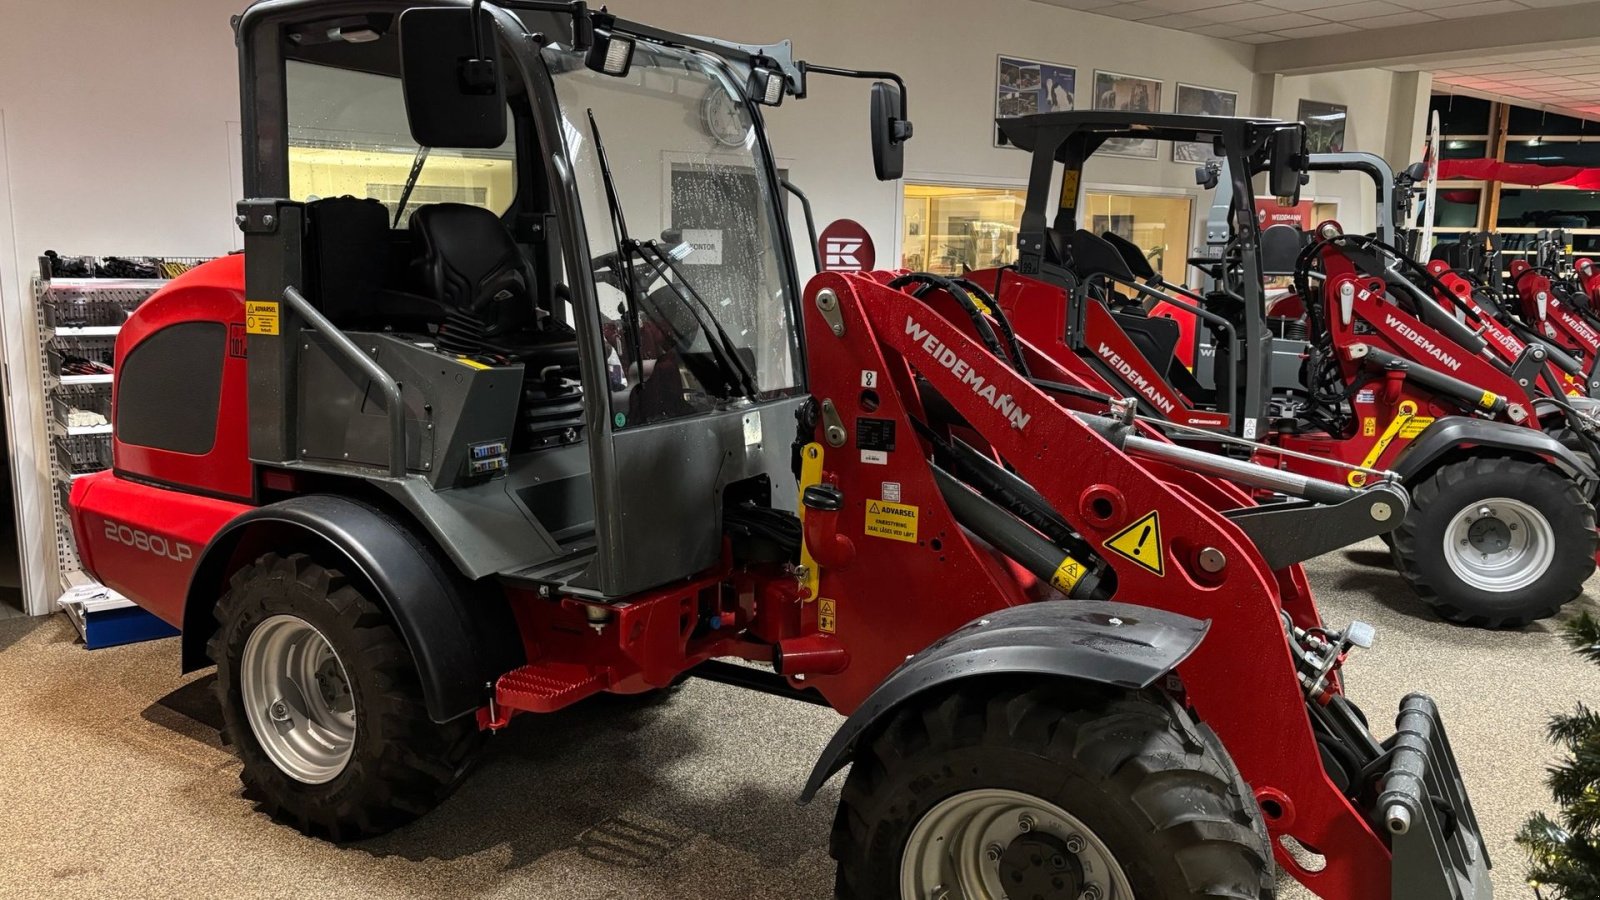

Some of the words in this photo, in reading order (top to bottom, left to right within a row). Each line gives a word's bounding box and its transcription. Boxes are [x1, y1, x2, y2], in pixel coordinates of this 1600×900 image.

[1271, 213, 1302, 221] WEIDEMANN
[232, 338, 243, 355] 101
[1385, 313, 1462, 371] WEIDEMANN
[905, 315, 1031, 430] WEIDEMANN
[1098, 342, 1174, 414] WEIDEMANN
[881, 506, 915, 518] ADVARSEL
[104, 519, 192, 562] 2080LP
